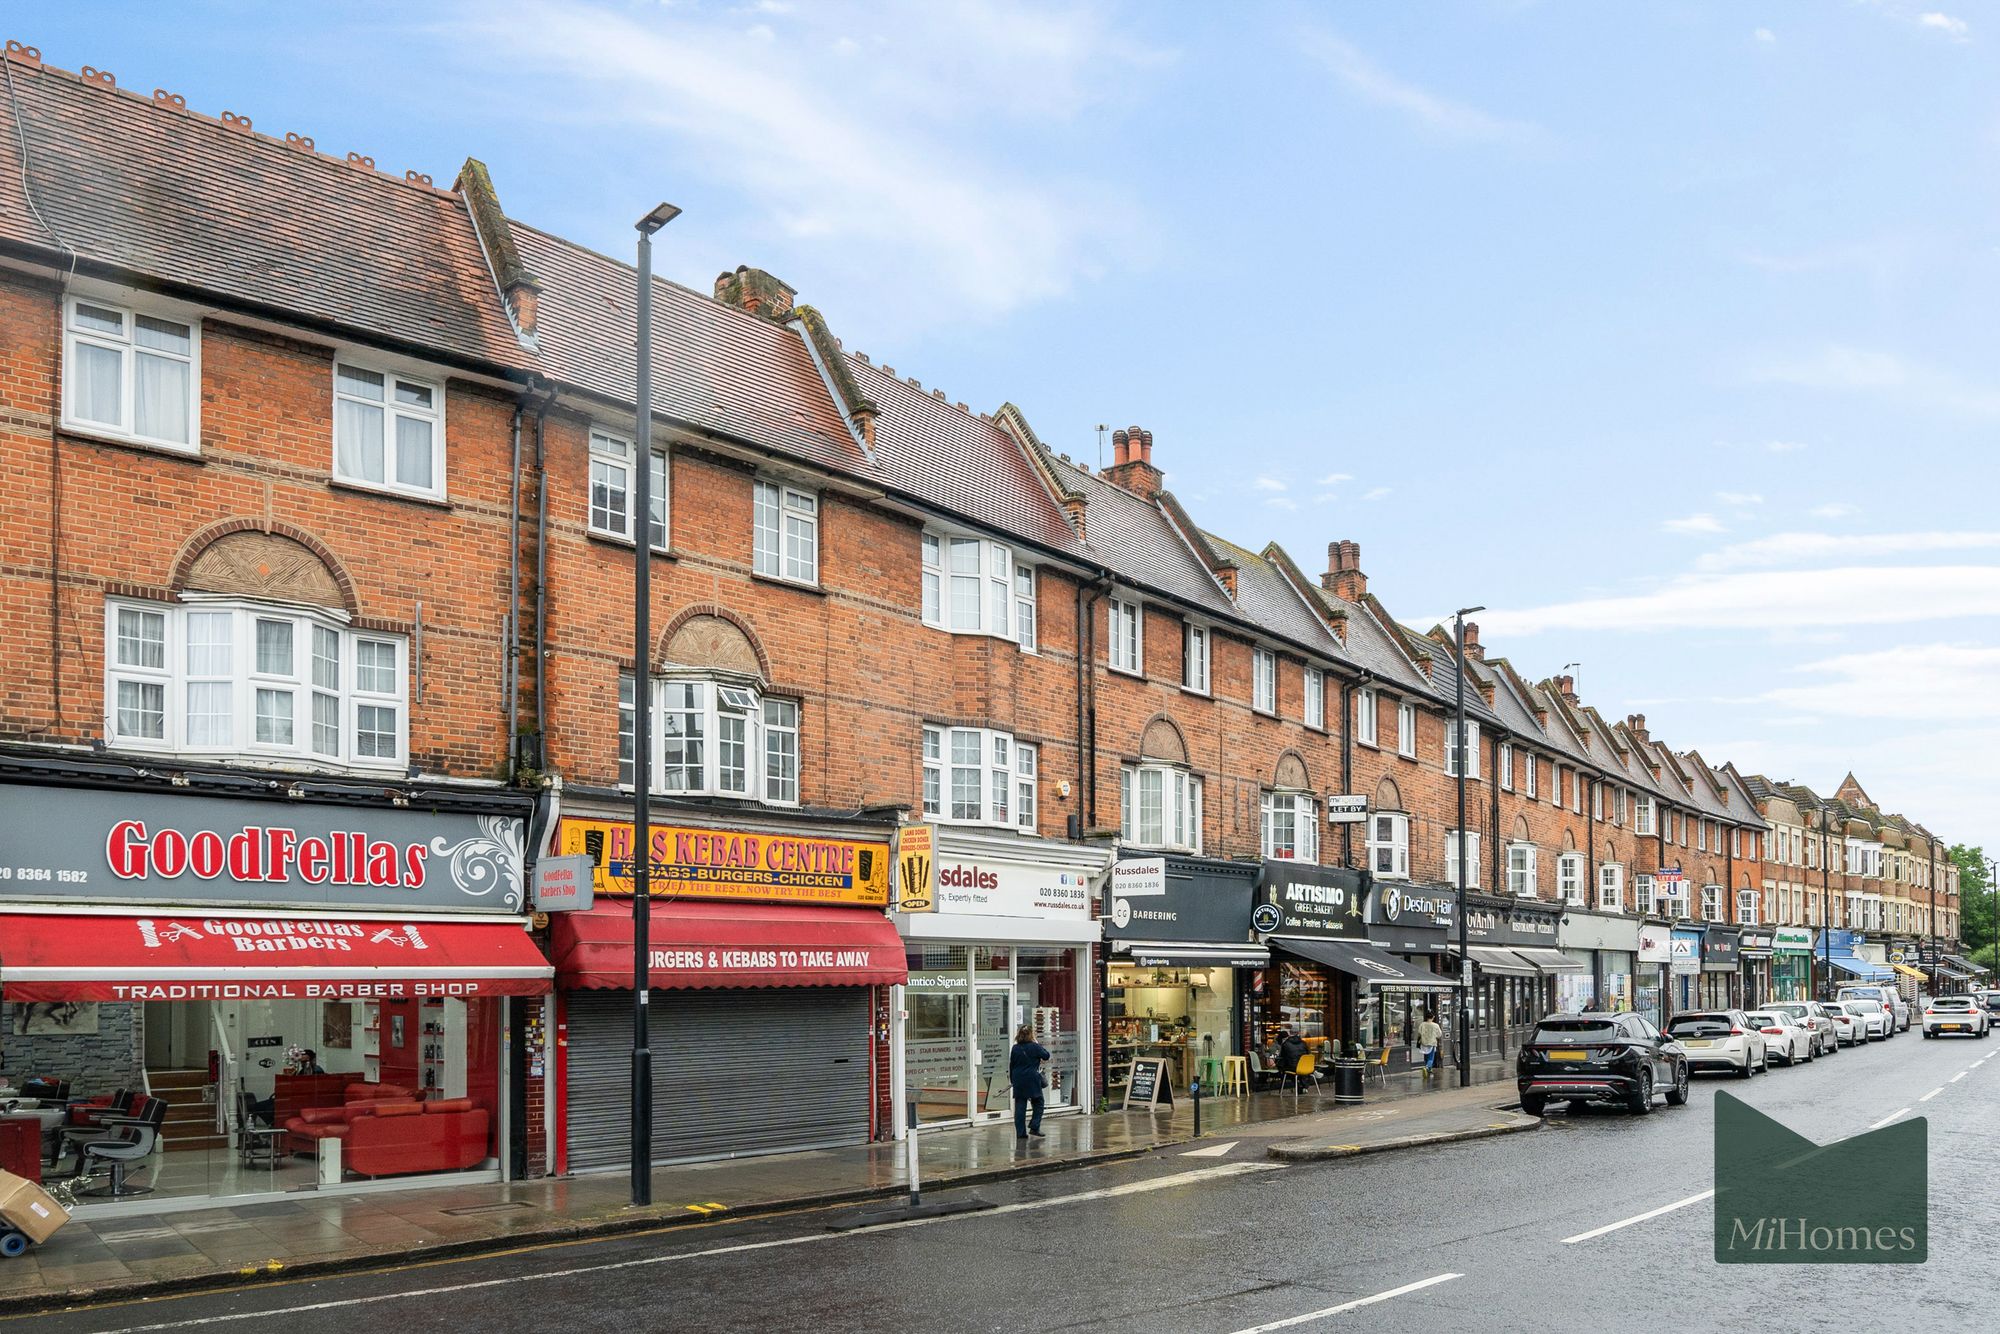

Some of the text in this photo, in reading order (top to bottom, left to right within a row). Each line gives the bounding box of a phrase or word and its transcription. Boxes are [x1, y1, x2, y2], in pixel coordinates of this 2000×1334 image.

[106, 820, 427, 889] GoodFellas
[674, 832, 760, 867] KEBAB
[766, 839, 854, 874] CENTRE
[17, 868, 51, 881] 8364
[56, 870, 88, 883] 1582
[621, 864, 843, 887] KBABS-BURGERS-CHICKEN
[939, 864, 998, 890] sdales
[1114, 865, 1159, 876] Russdales
[652, 881, 685, 891] TRIED
[690, 881, 711, 892] THE
[775, 886, 795, 896] TRY
[796, 887, 819, 897] THE
[821, 888, 843, 898] BEST
[1039, 888, 1085, 899] 020 8360 1836
[1127, 882, 1143, 890] 8360
[1144, 881, 1160, 889] 1836
[1286, 882, 1344, 905] ARTISIMO
[948, 893, 972, 903] Expertly
[973, 894, 988, 903] fitted
[1034, 901, 1085, 910] www.russdales.co.uk
[1404, 895, 1453, 917] Destiny Hair
[1132, 910, 1177, 921] BARBERING
[1294, 903, 1335, 915] GREEK BAKERY
[203, 919, 365, 937] GoodFellas
[1285, 917, 1301, 927] Coffee
[1466, 911, 1495, 929] OVANNI
[231, 935, 352, 952] Barbers
[648, 951, 870, 968] URGERS & KEBABS TO TAKE AWAY
[113, 982, 479, 1000] TRADITIONAL BARBER SHOP
